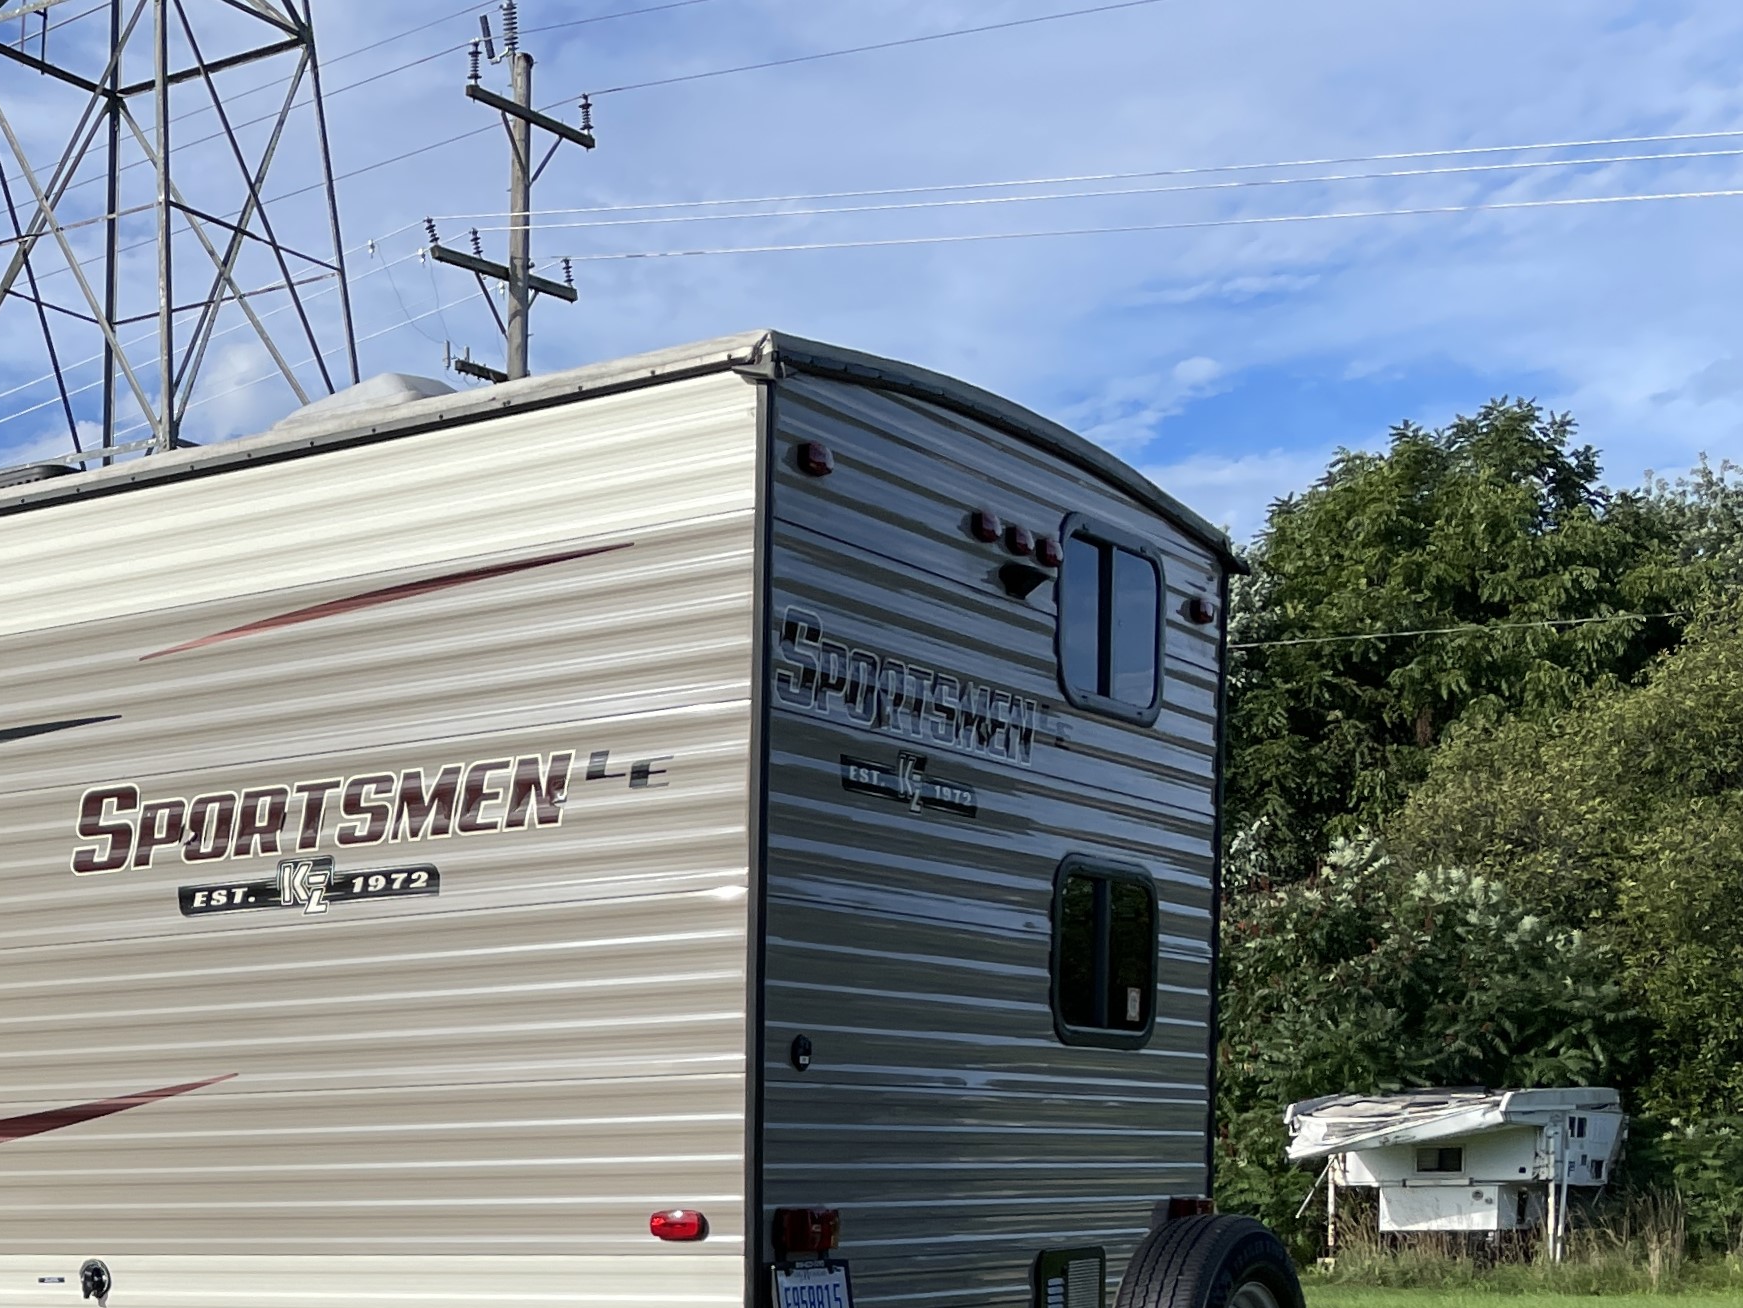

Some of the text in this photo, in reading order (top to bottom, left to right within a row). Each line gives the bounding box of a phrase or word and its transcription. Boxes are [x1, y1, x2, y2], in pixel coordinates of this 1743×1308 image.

[774, 604, 1039, 767] SPORTSMEN
[69, 748, 576, 876] SPORTSMEN
[849, 765, 886, 787] EST.
[934, 785, 973, 806] 1972
[191, 886, 257, 909] EST.
[351, 869, 430, 894] 1972
